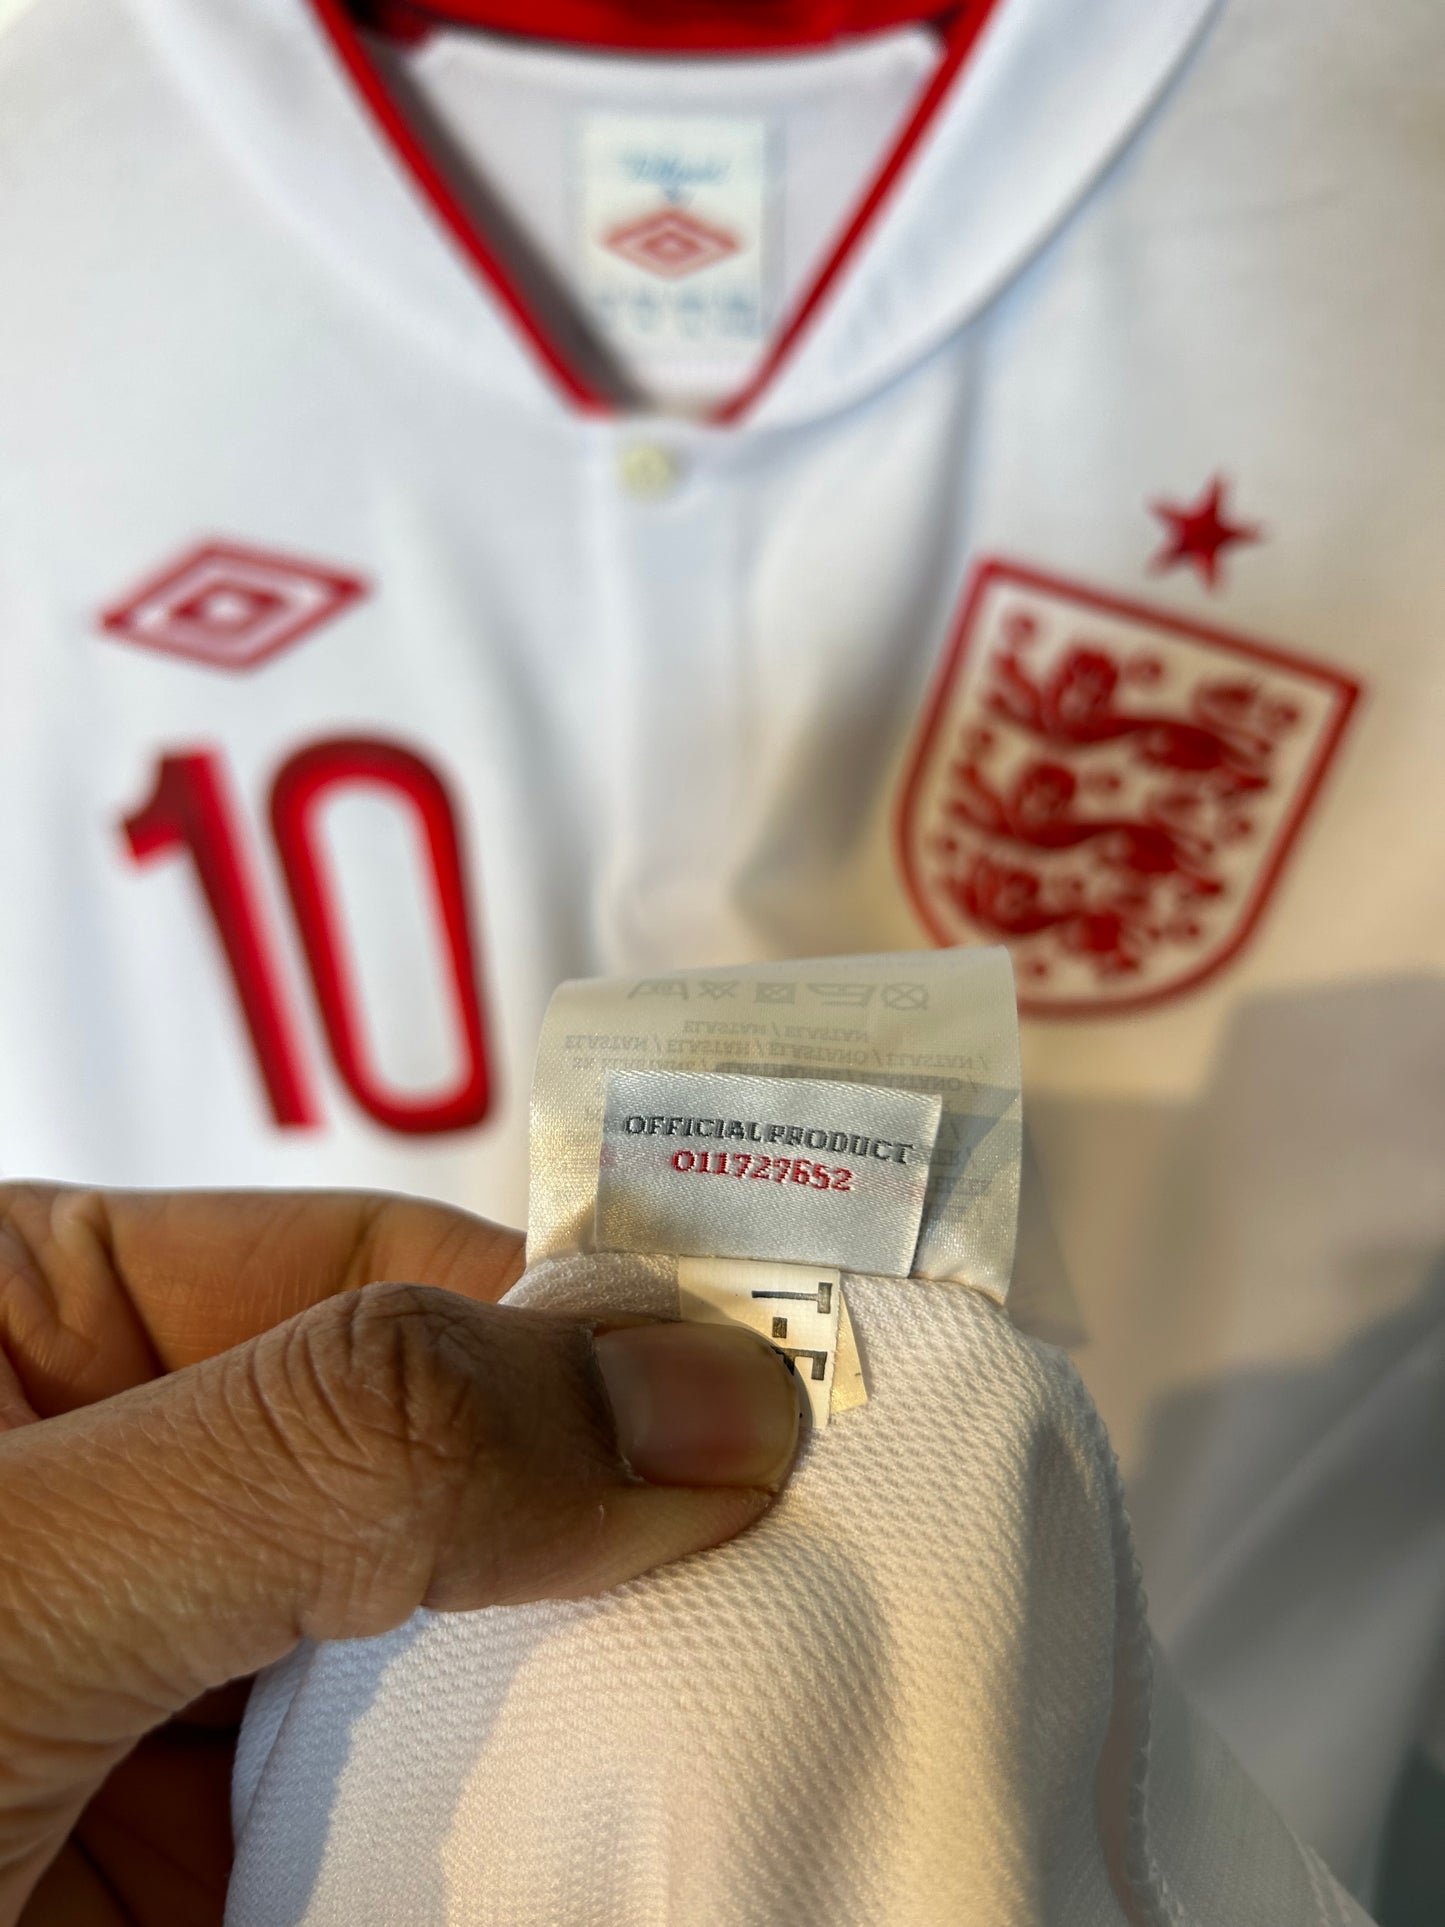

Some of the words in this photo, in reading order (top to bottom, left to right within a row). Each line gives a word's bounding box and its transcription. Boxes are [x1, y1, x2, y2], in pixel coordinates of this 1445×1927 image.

[122, 737, 493, 1133] 10
[624, 1114, 763, 1143] OFFICIAL
[764, 1122, 913, 1164] PRODUCT
